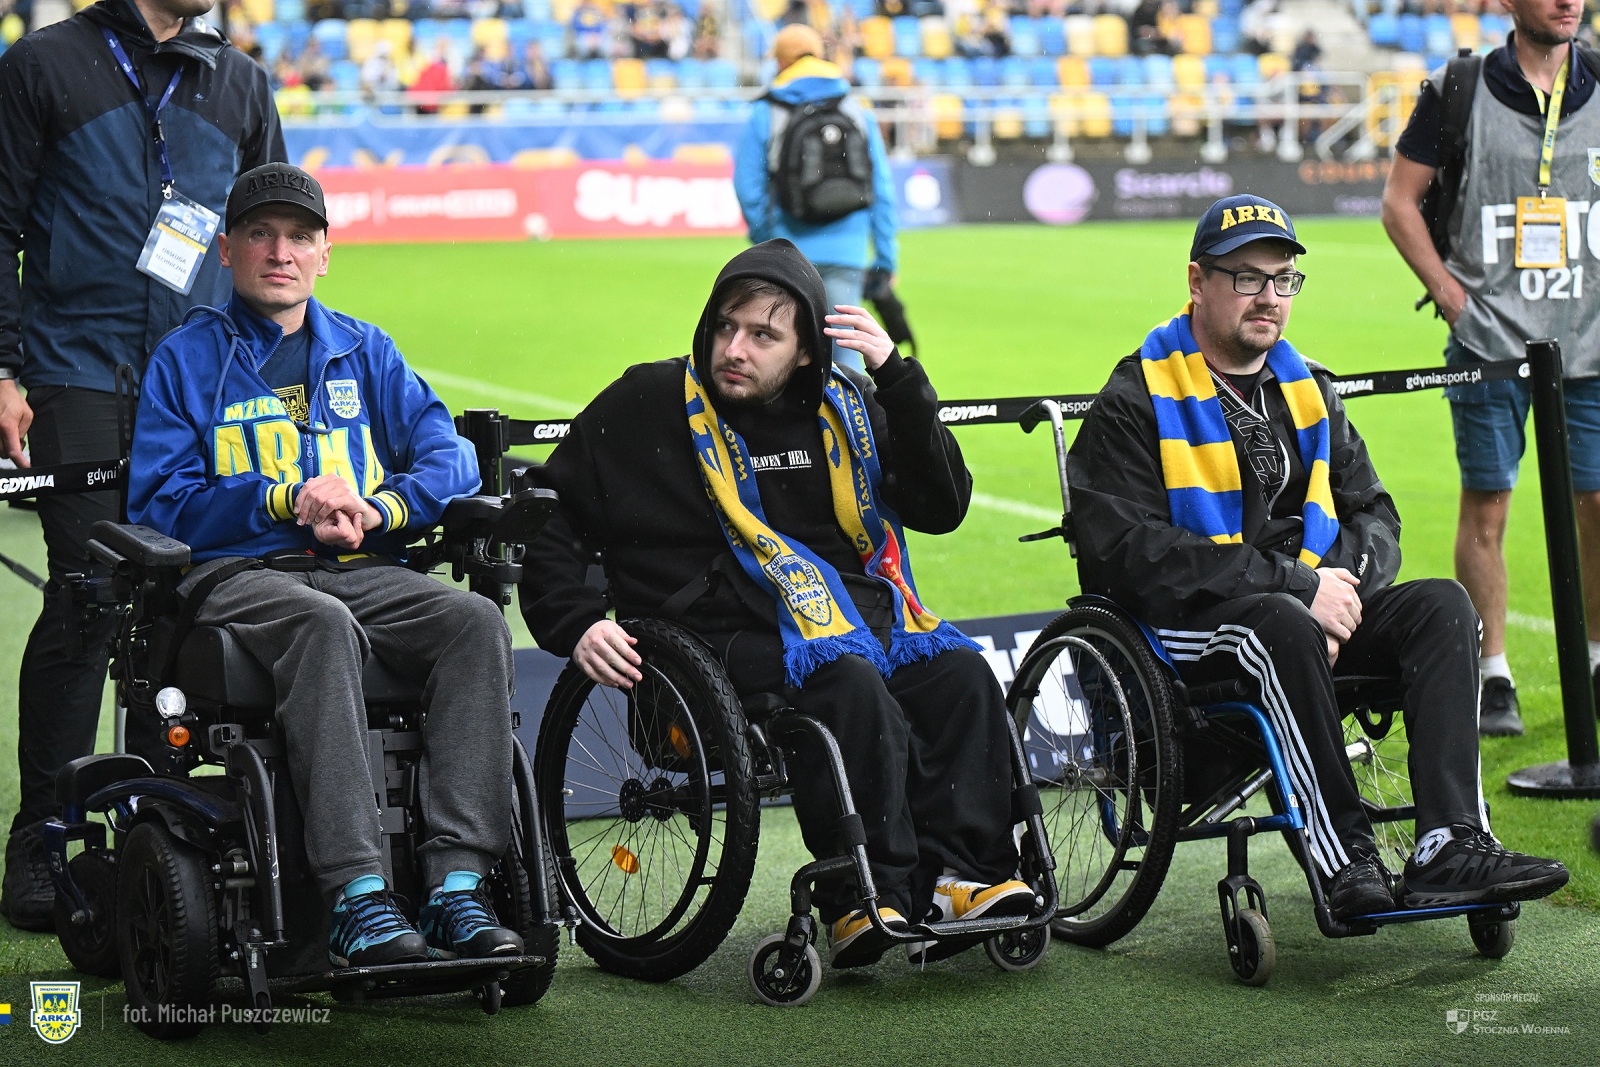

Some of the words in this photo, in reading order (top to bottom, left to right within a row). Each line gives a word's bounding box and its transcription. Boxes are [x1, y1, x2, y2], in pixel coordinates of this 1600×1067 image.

[245, 171, 315, 200] ARKA
[1220, 204, 1288, 231] ARKA
[1481, 199, 1600, 264] FT
[1519, 264, 1584, 300] 021
[1333, 378, 1374, 395] DYNIA
[1405, 368, 1482, 391] gdyniasport.pl
[223, 395, 287, 423] MZKS
[937, 404, 998, 422] GDYNIA
[533, 423, 570, 439] GDY
[786, 450, 812, 465] HELL
[0, 474, 54, 494] GDYNIA
[87, 466, 117, 485] gdyni
[796, 589, 821, 604] ARKA
